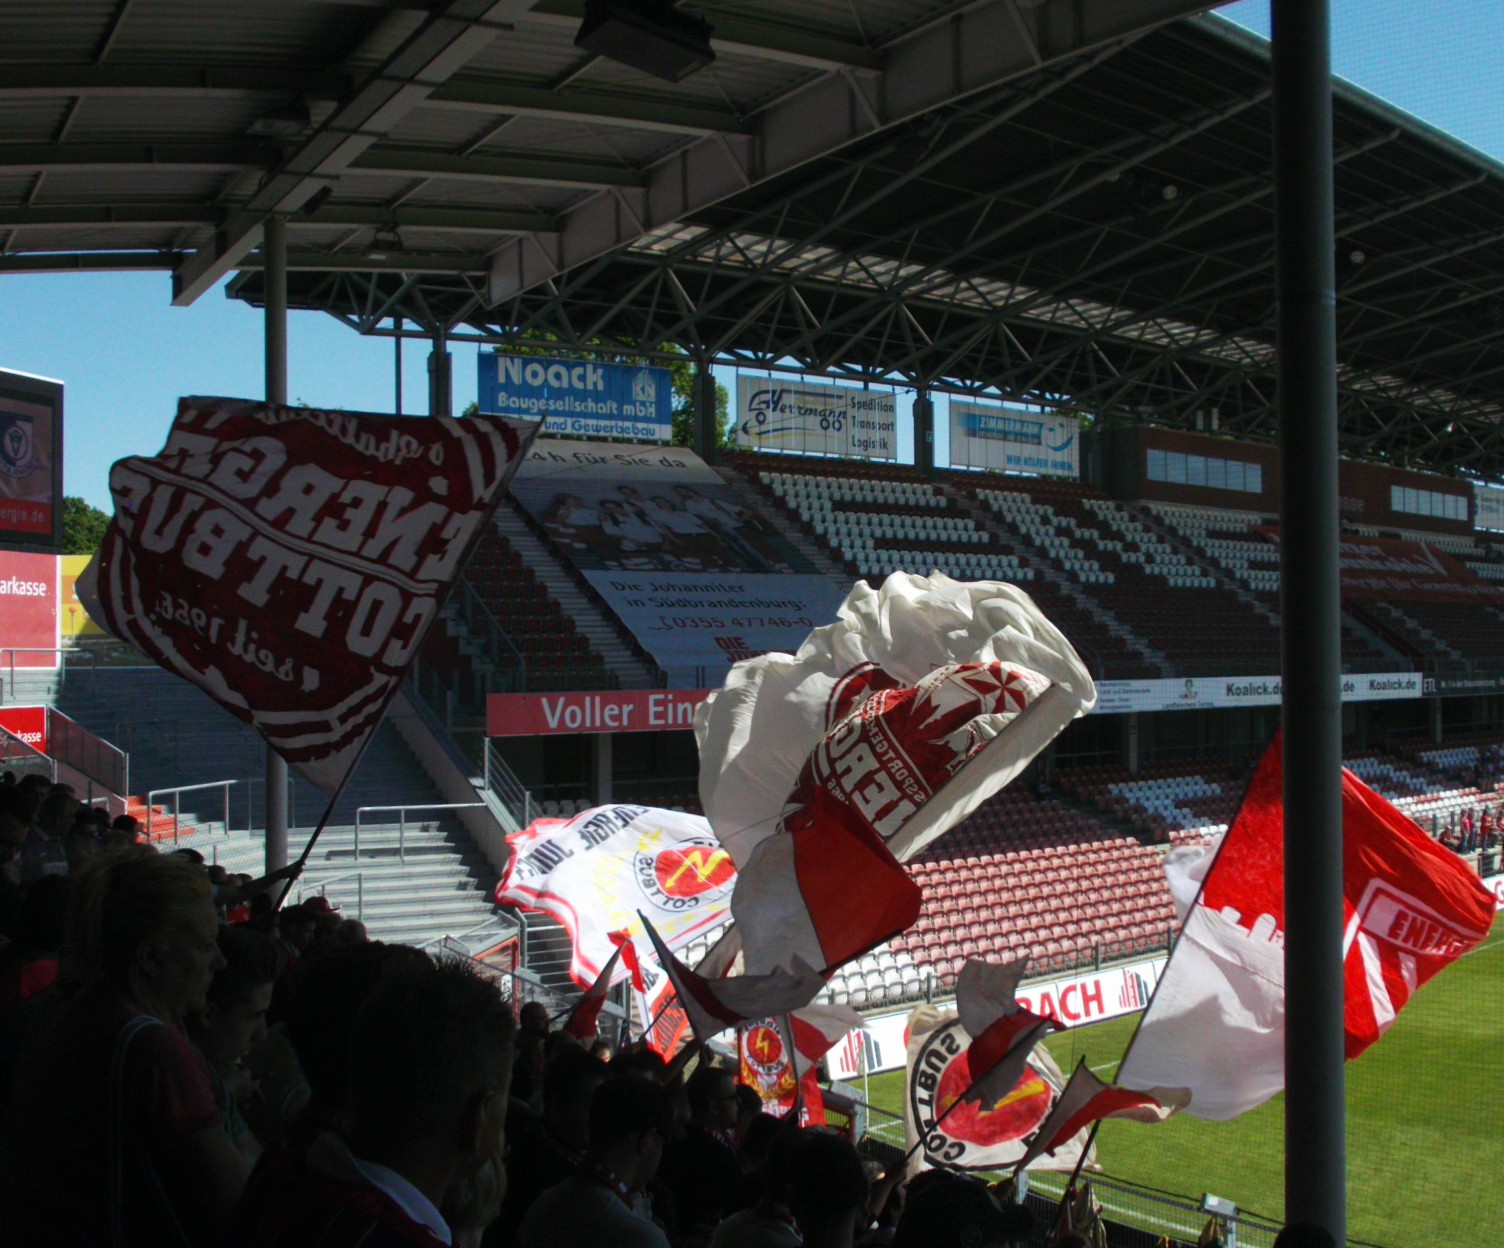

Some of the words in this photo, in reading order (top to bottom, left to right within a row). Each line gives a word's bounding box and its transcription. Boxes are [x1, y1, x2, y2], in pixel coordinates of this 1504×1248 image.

[498, 356, 604, 392] Noack
[498, 391, 618, 415] Baugesellschaft
[623, 400, 656, 418] mbH
[850, 396, 895, 413] Spedition
[544, 417, 568, 432] und
[571, 420, 656, 437] Gewerbebau
[851, 416, 895, 432] Transport
[852, 434, 888, 451] Logistik
[573, 451, 607, 466] für
[659, 455, 688, 469] da
[541, 695, 635, 730] Voller
